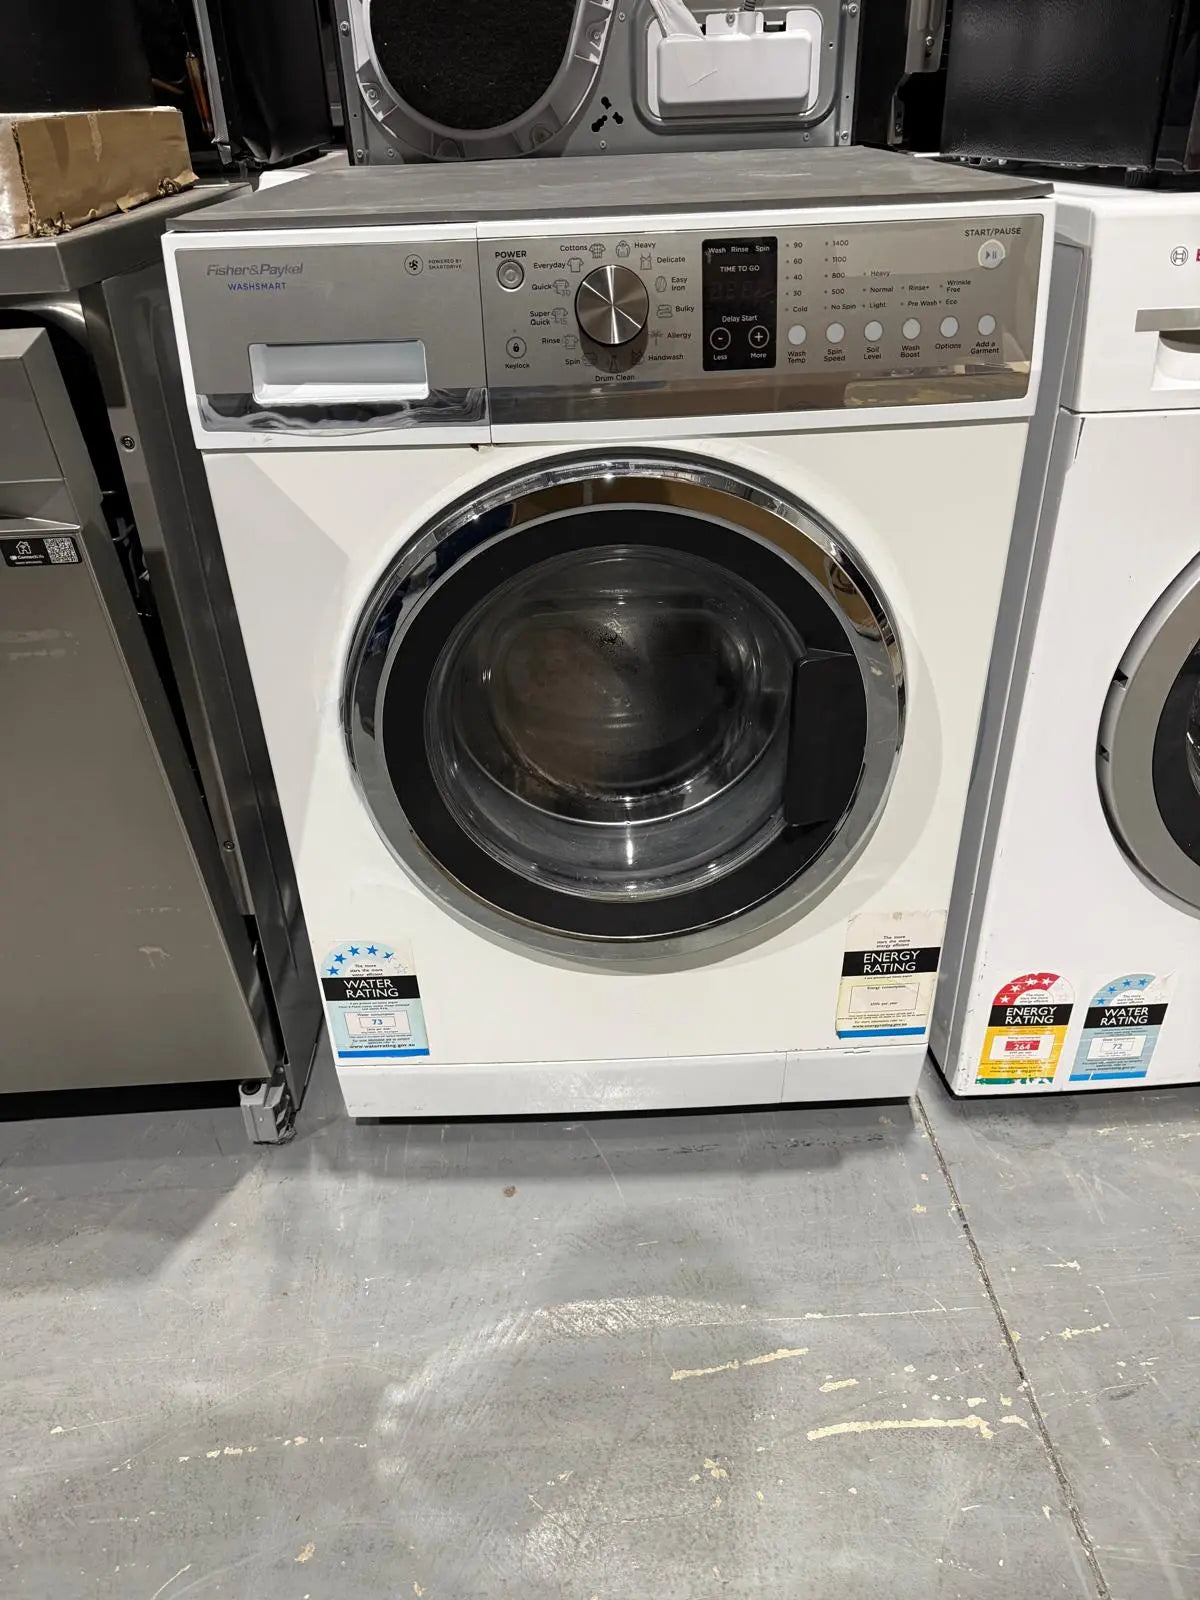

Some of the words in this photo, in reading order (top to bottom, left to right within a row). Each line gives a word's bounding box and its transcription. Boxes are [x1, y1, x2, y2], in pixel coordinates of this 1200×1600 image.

[965, 227, 1022, 237] START/PAUSE
[560, 244, 588, 252] Cottons
[634, 241, 656, 249] Heavy
[495, 251, 527, 259] POWER
[207, 263, 303, 276] Fisher&Paykel
[871, 270, 890, 278] Heavy
[671, 276, 688, 284] Easy
[228, 282, 286, 291] WASHSMART
[676, 305, 695, 313] Bulky
[842, 303, 857, 311] Spin
[721, 315, 740, 323] Delay
[667, 331, 691, 339] Allergy
[971, 347, 999, 355] Garment
[864, 950, 920, 963] ENERGY
[864, 962, 916, 973] RATING
[344, 979, 394, 989] WATER
[346, 988, 399, 998] RATING
[1006, 1007, 1057, 1016] ENERGY
[1105, 1007, 1149, 1017] WATER
[1005, 1015, 1054, 1024] RATING
[1100, 1016, 1149, 1026] RATING
